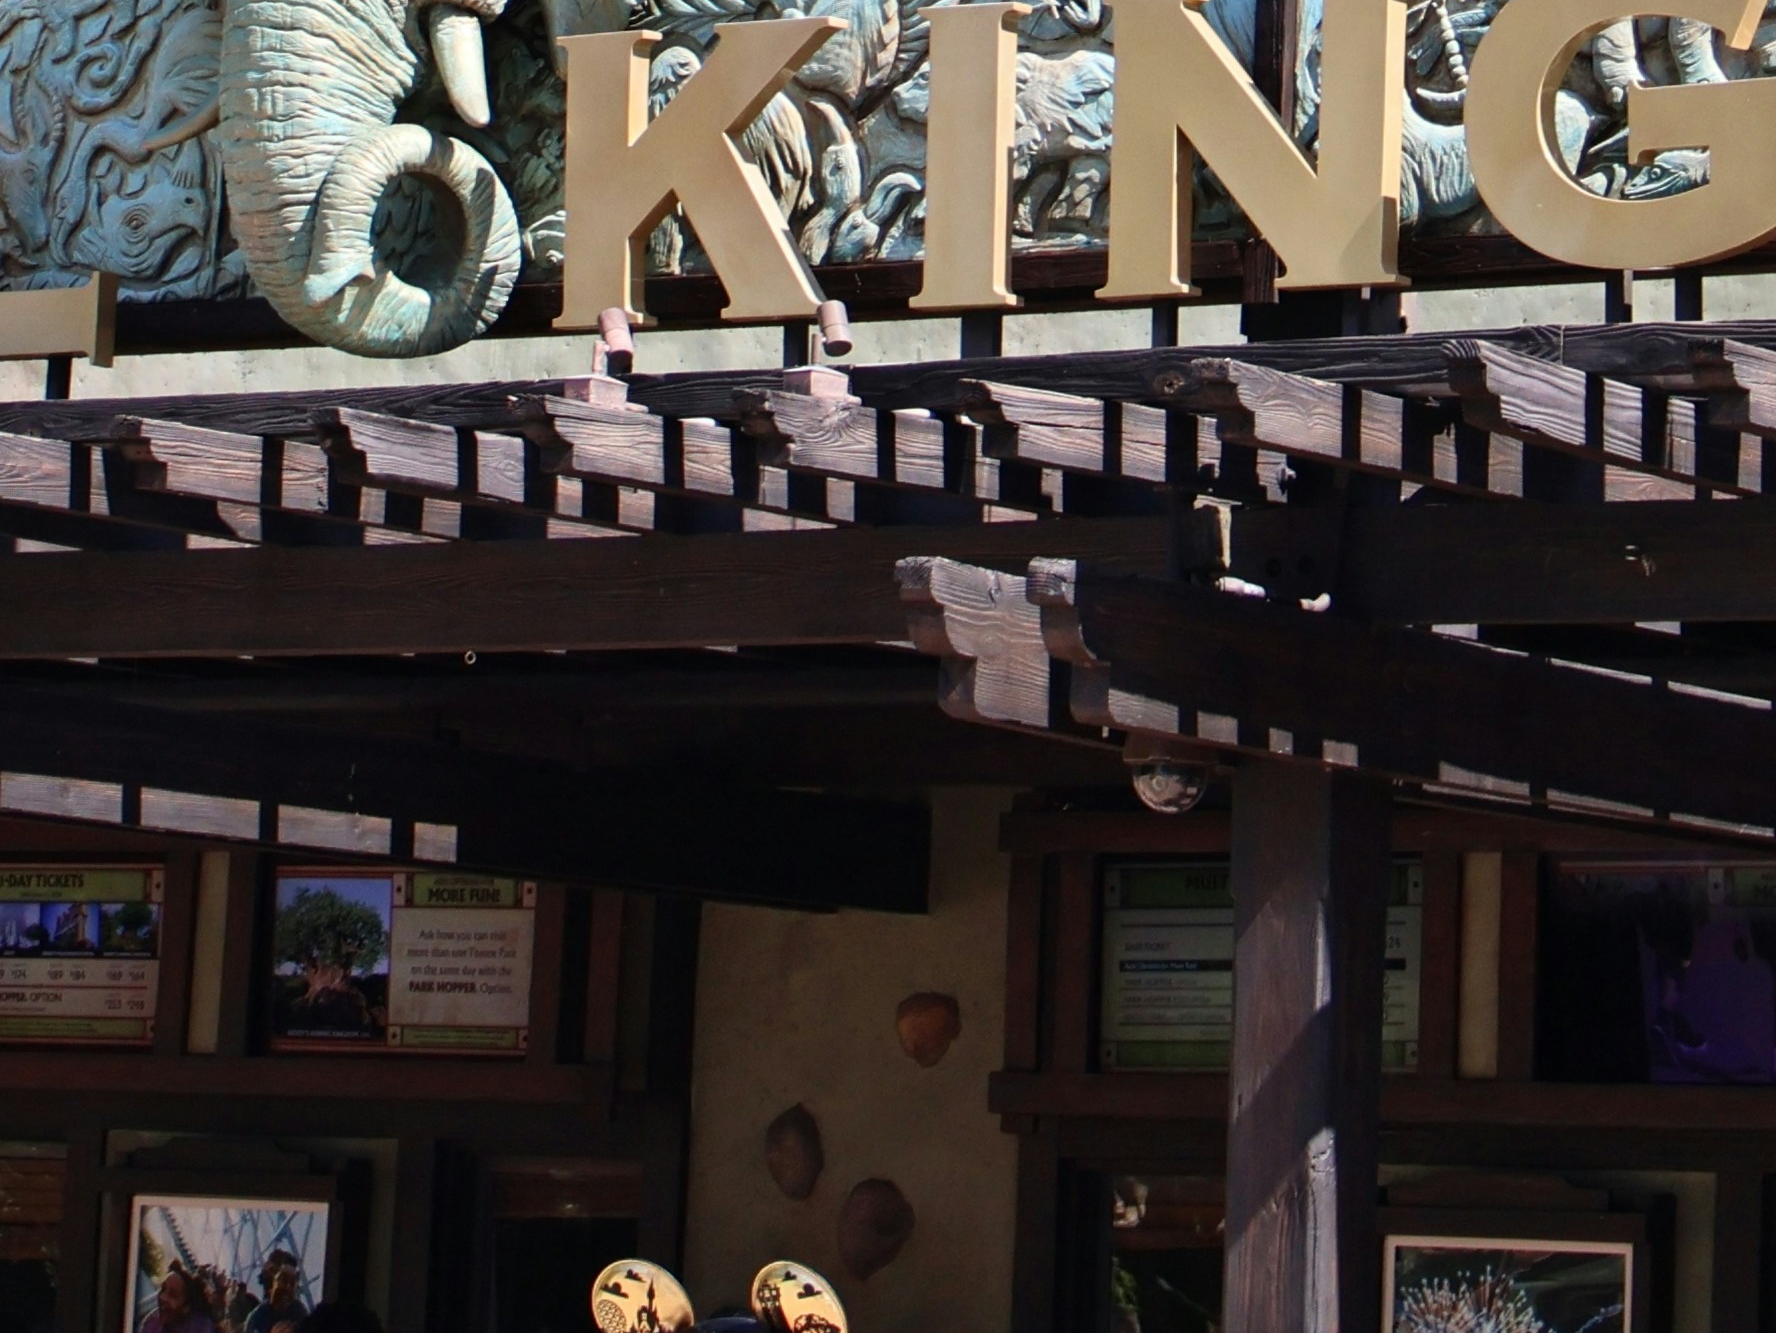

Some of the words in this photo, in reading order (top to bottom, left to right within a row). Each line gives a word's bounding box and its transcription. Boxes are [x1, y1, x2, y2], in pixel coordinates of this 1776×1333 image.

[35, 874, 84, 888] TICKETS
[428, 888, 466, 902] MORE
[470, 888, 501, 902] FUN!
[409, 981, 435, 992] PARK
